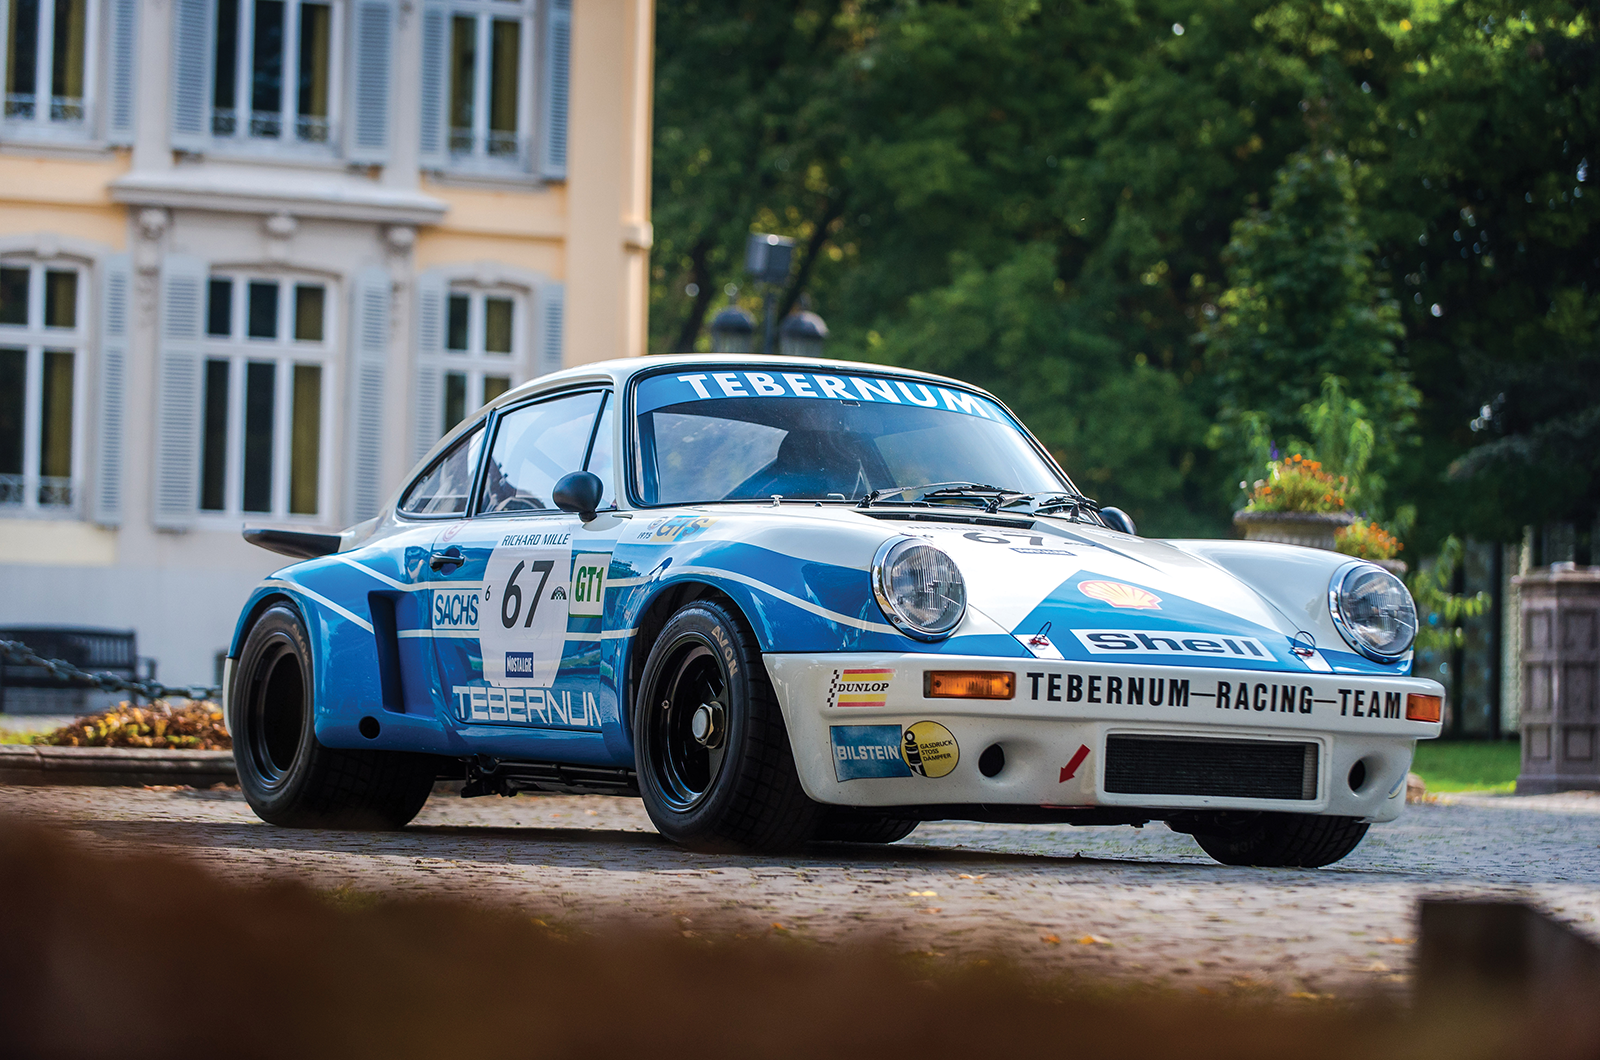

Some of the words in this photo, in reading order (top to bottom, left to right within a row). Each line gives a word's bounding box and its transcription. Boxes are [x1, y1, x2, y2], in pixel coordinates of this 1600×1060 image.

[677, 372, 990, 418] TEBERNUM
[656, 516, 710, 537] GTS
[501, 534, 541, 546] RICHARD
[541, 533, 571, 545] MILLE
[963, 532, 1044, 546] 67
[484, 585, 491, 601] 6
[501, 560, 555, 629] 67
[575, 566, 602, 602] GT1
[434, 593, 479, 626] SACHS
[711, 625, 738, 677] AVON
[1086, 633, 1264, 657] Shell
[837, 682, 889, 692] DUNLOP
[837, 746, 900, 761] BILSTEIN
[920, 740, 953, 749] GASDRUCK
